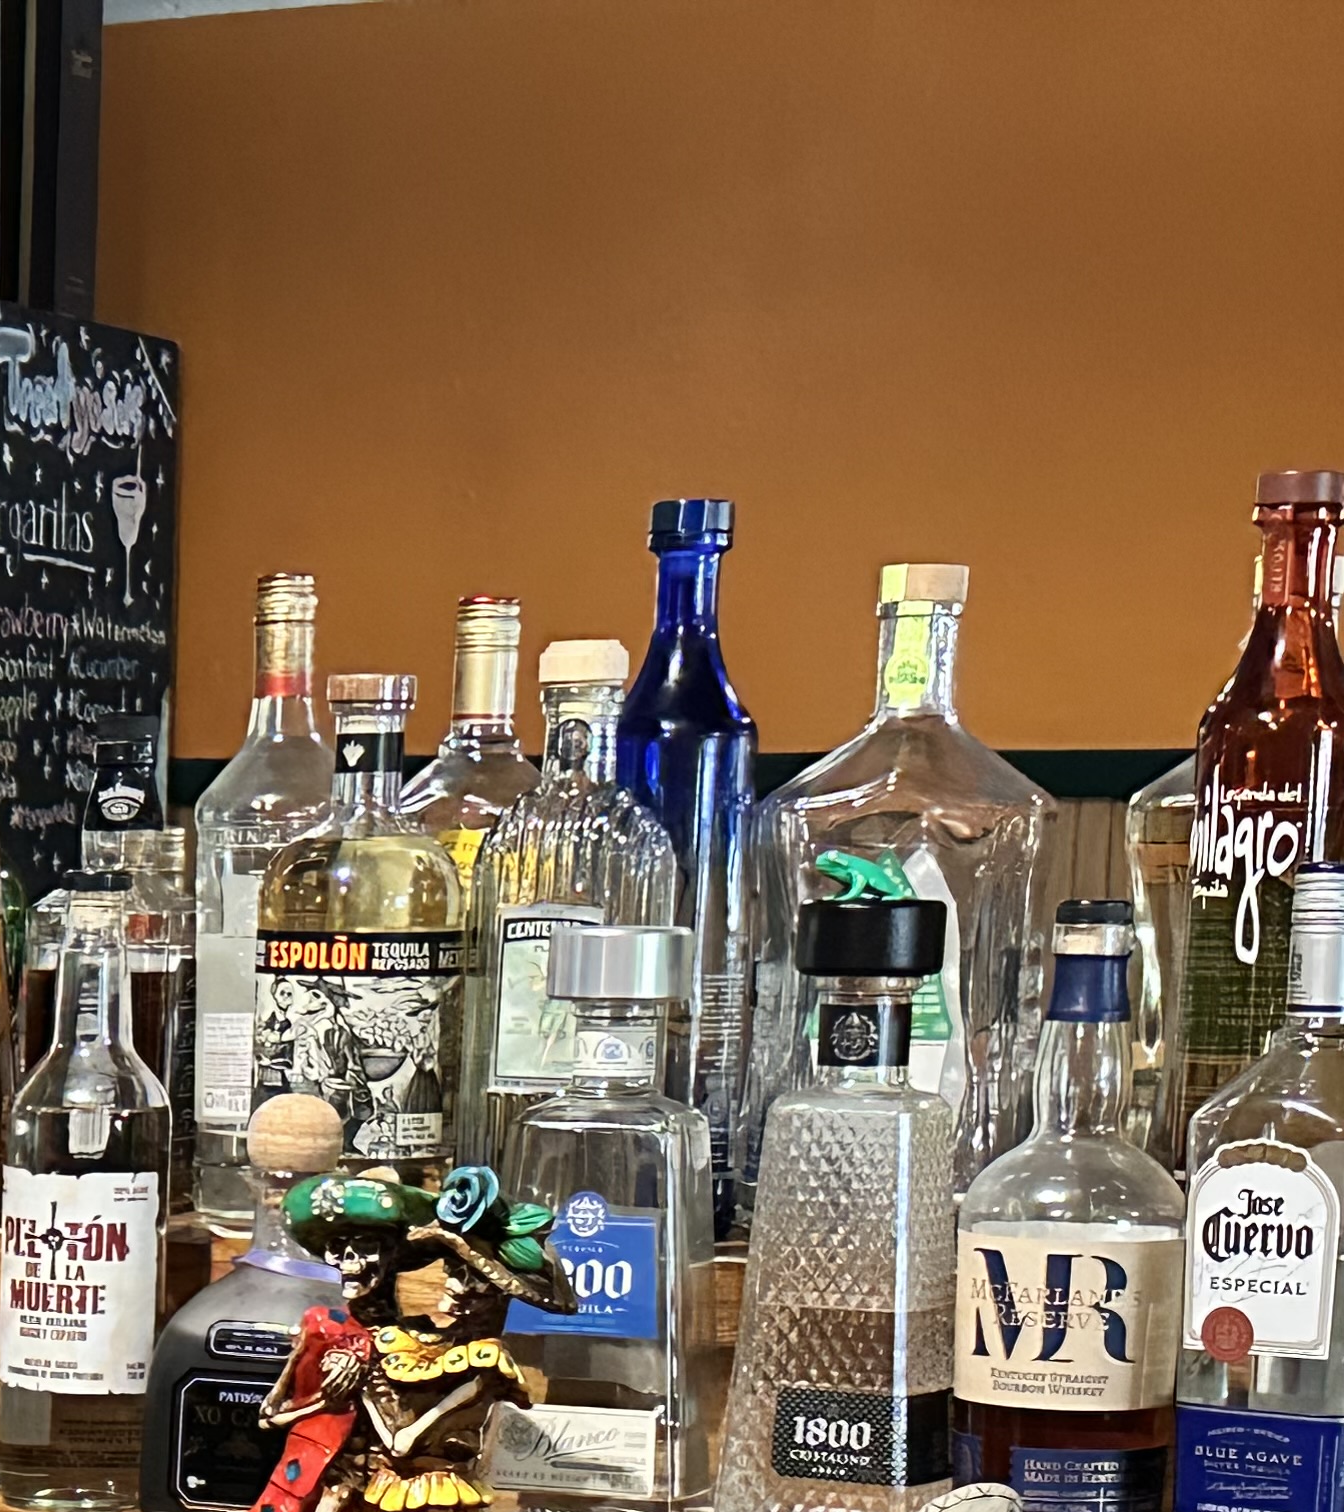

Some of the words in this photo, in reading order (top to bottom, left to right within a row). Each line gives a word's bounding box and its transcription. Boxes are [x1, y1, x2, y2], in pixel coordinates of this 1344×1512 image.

[1277, 782, 1302, 803] del
[506, 920, 584, 939] CENTE
[372, 942, 431, 957] TEQUILA
[1236, 1188, 1285, 1220] Jose
[1202, 1206, 1314, 1264] Cuervo
[25, 1262, 42, 1279] DE
[65, 1265, 86, 1282] LA
[562, 1259, 633, 1300] 00
[10, 1278, 107, 1315] MUERTE
[1210, 1276, 1307, 1297] ESPECIAL
[972, 1247, 1136, 1364] MR
[793, 1415, 872, 1451] 1800
[1194, 1445, 1238, 1460] BLUE
[1245, 1452, 1304, 1467] AGAVE
